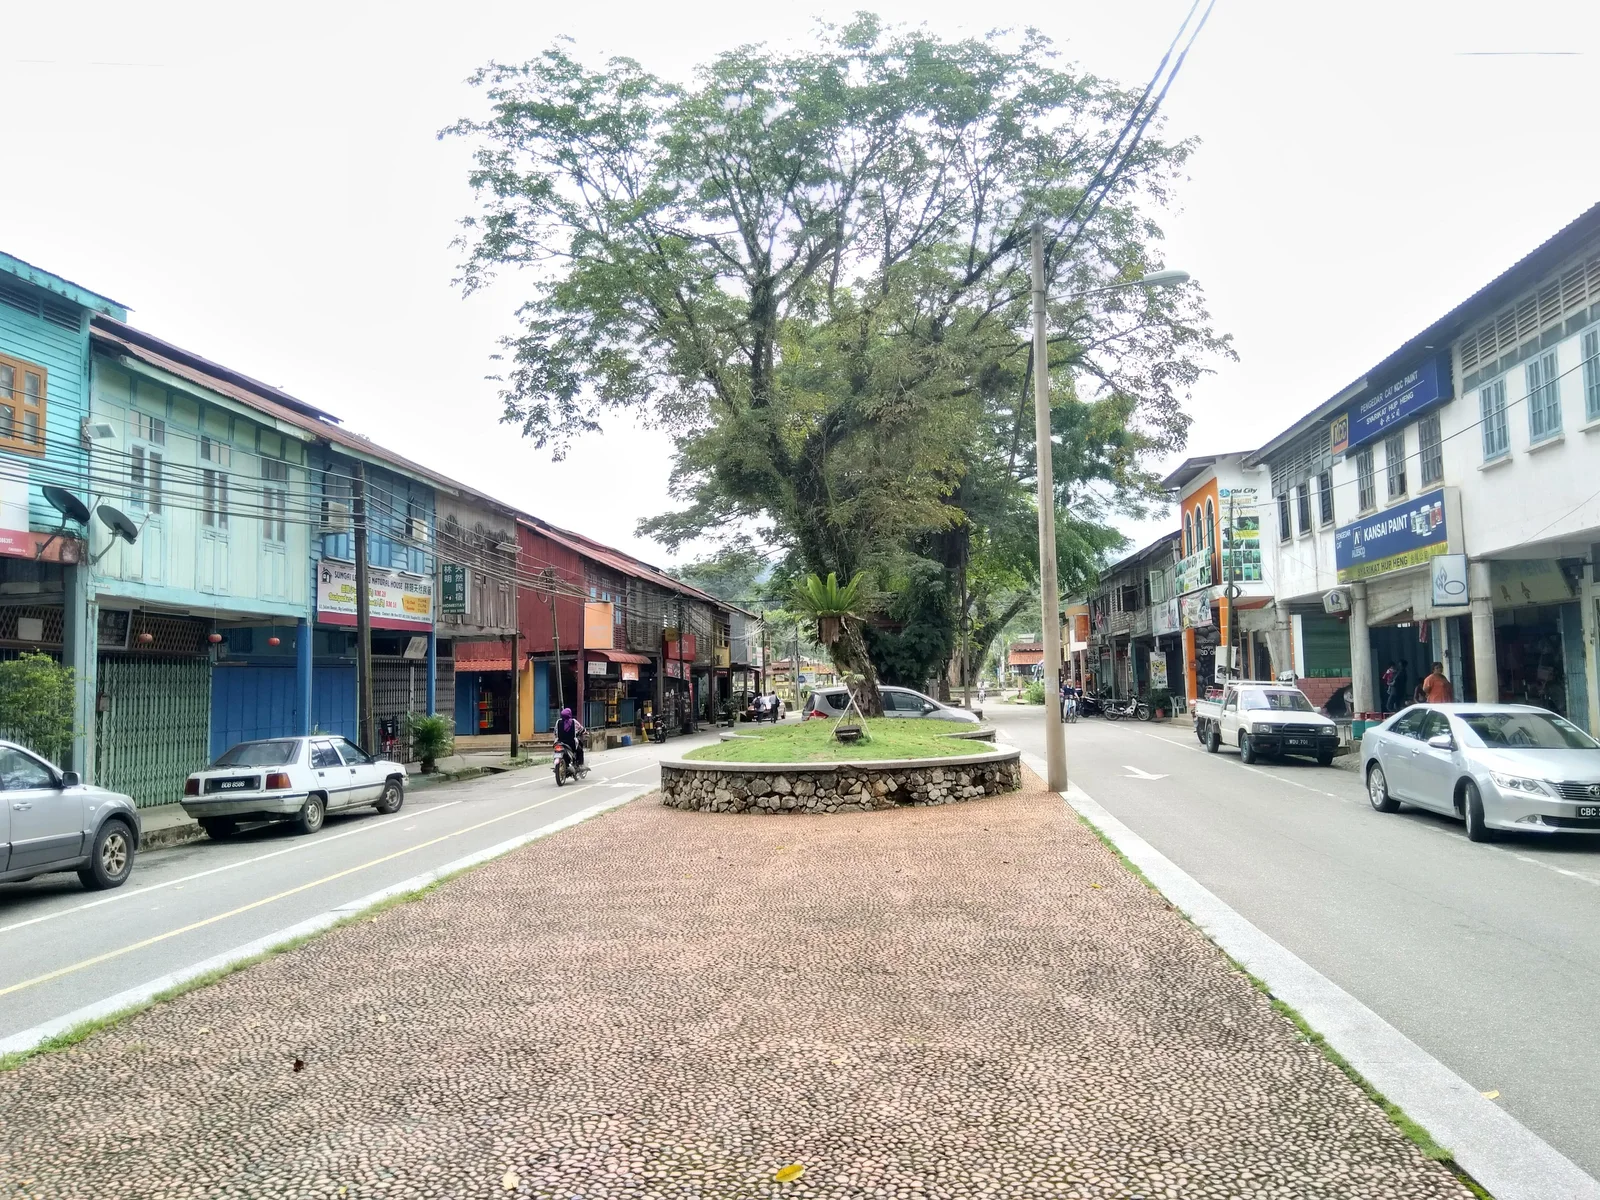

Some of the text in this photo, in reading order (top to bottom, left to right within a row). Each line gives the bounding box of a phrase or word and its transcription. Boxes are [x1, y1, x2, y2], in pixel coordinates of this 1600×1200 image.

[1360, 393, 1383, 414] PENGEDAR
[1384, 386, 1393, 398] CAT
[1404, 370, 1418, 386] PAINT
[1366, 391, 1414, 425] SYARIKAT HUP HENG
[1335, 529, 1351, 540] PENGEDAR
[1363, 514, 1408, 542] KANSAI PAINT
[1357, 556, 1408, 577] SYARIKAT HUP HENG
[334, 571, 352, 580] SUNGAI
[371, 577, 390, 587] NATURAL
[390, 580, 403, 590] HOUSE
[1580, 807, 1597, 816] CBC
